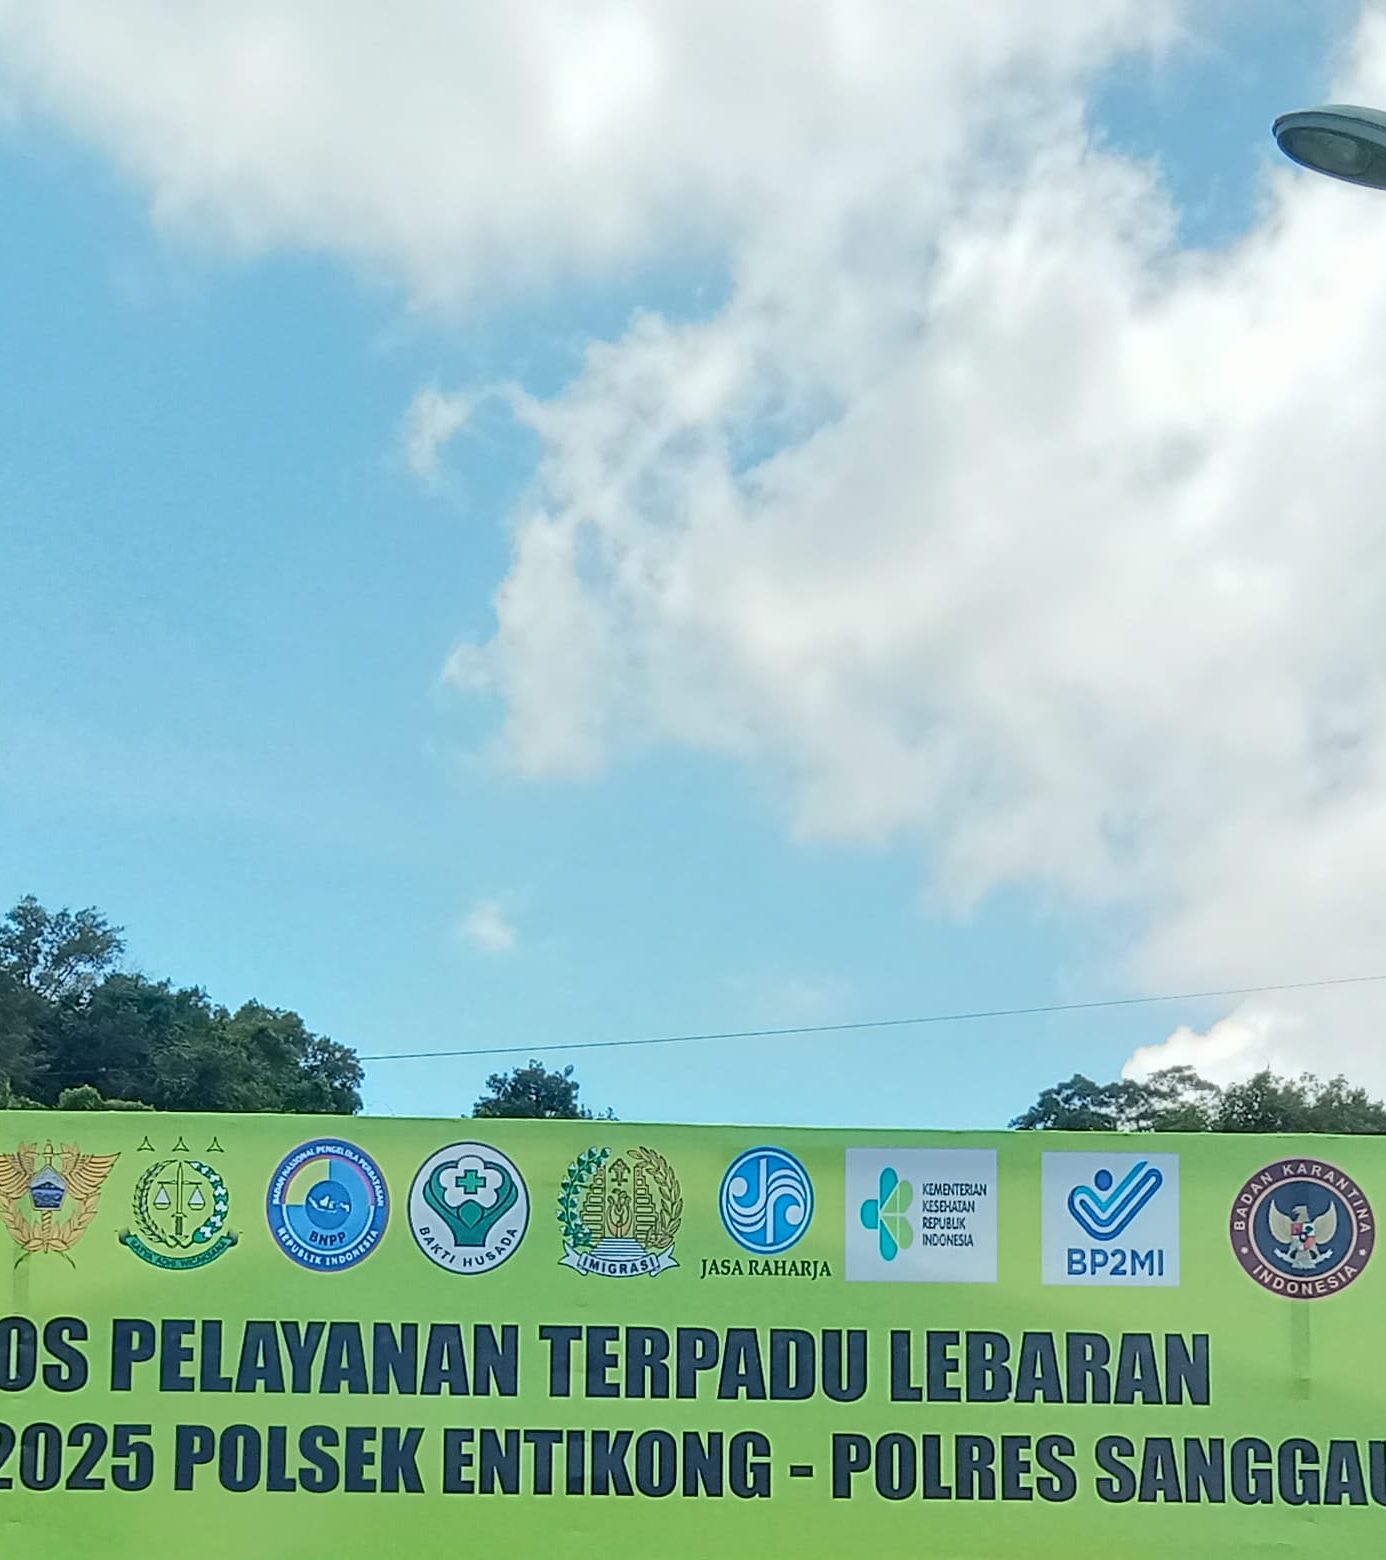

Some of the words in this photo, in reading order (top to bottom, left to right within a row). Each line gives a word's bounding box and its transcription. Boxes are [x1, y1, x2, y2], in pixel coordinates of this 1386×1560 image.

[922, 1183, 988, 1196] KEMENTERIAN
[1233, 1172, 1273, 1231] BADAN
[1282, 1163, 1372, 1234] KARANTINA
[922, 1200, 976, 1213] KESEHATAN
[922, 1217, 966, 1230] REPUBLIK
[277, 1227, 322, 1264] REPUBLIK
[325, 1229, 379, 1265] INDONESIA
[309, 1230, 346, 1246] BNPP
[419, 1227, 456, 1265] BAKTI
[462, 1228, 518, 1267] HUSADA
[922, 1234, 974, 1247] INDONESIA
[581, 1256, 657, 1275] IMIGRASI
[700, 1258, 744, 1279] JASA
[748, 1259, 832, 1280] RAHARJA
[1066, 1248, 1165, 1276] BP2MI
[1253, 1264, 1358, 1295] INDONESIA
[110, 1318, 519, 1397] PELAYANAN
[539, 1325, 869, 1402] TERPADU
[888, 1329, 1211, 1406] LEBARAN
[173, 1424, 426, 1495] POLSEK
[442, 1427, 772, 1499] ENTIKONG
[789, 1464, 814, 1479] -
[831, 1431, 1078, 1504] POLRES
